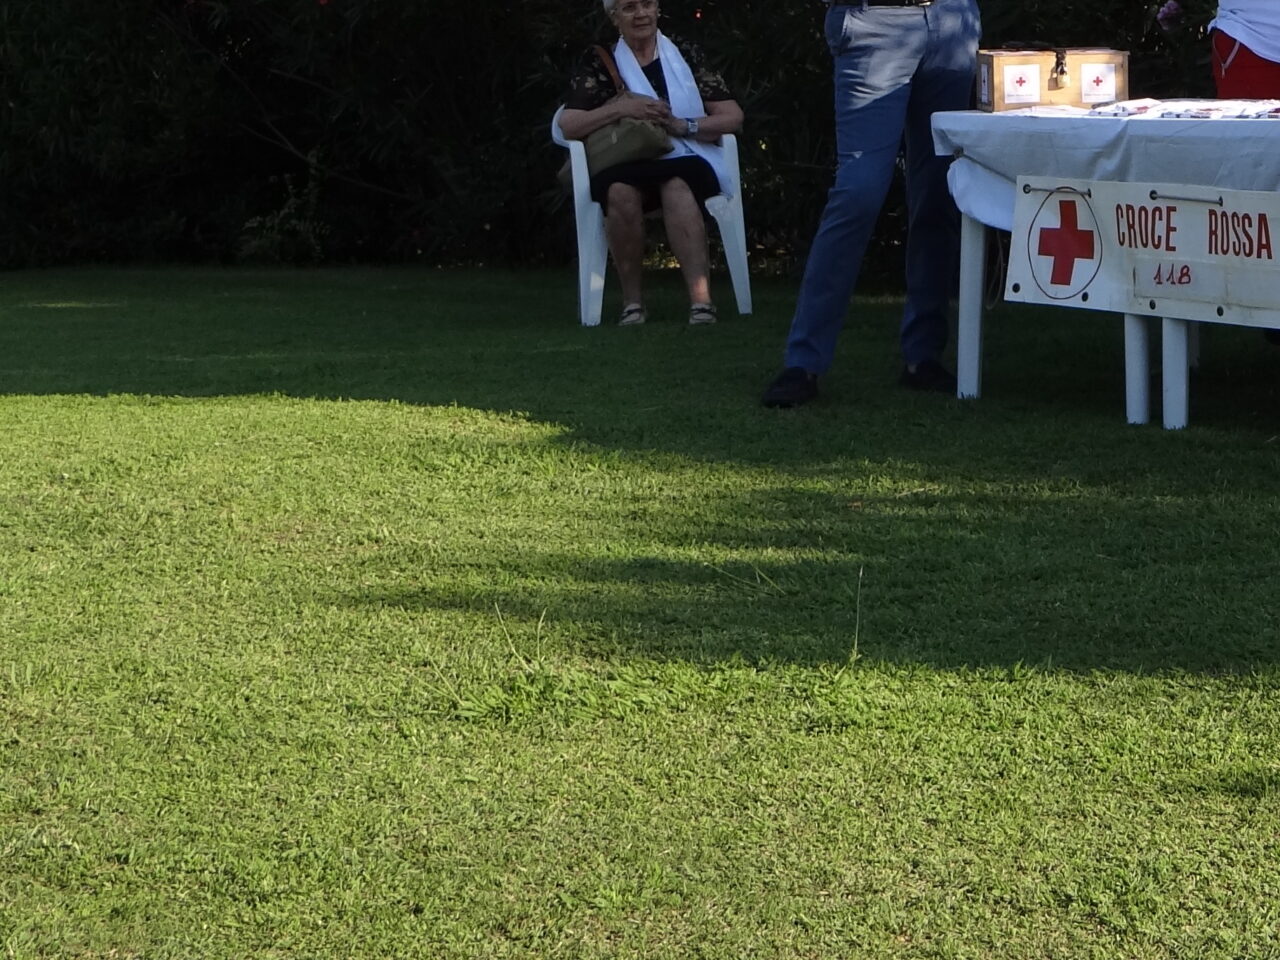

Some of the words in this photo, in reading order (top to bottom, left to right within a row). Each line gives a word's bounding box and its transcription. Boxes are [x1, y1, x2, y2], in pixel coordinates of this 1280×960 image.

[1115, 203, 1177, 251] CROCE
[1208, 208, 1273, 259] ROSSA
[1153, 263, 1192, 285] 118
